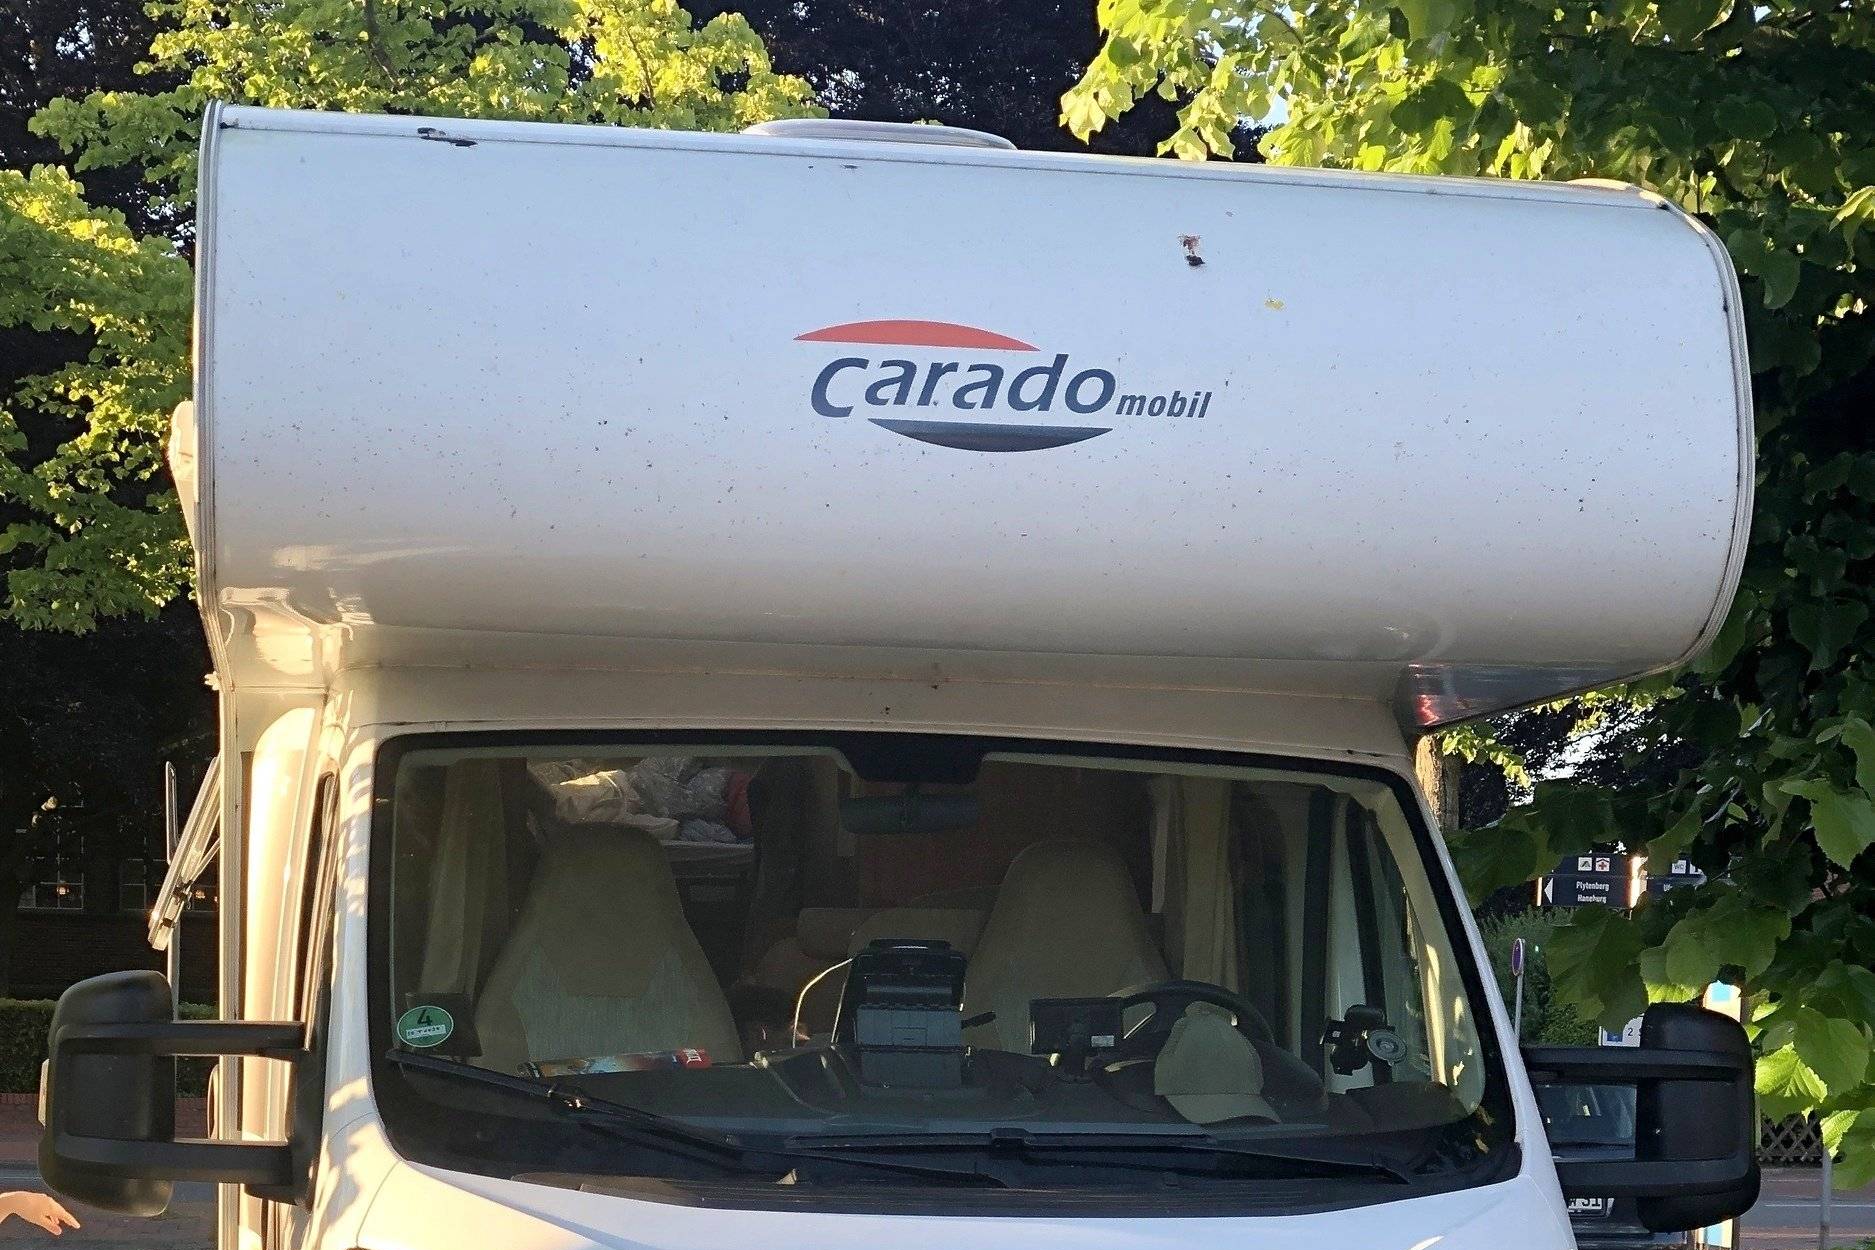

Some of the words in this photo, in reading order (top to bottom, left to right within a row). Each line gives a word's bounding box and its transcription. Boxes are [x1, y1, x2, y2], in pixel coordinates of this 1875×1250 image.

[1115, 390, 1213, 419] mobil
[1576, 881, 1610, 891] Plytenberg
[417, 1009, 433, 1025] 4
